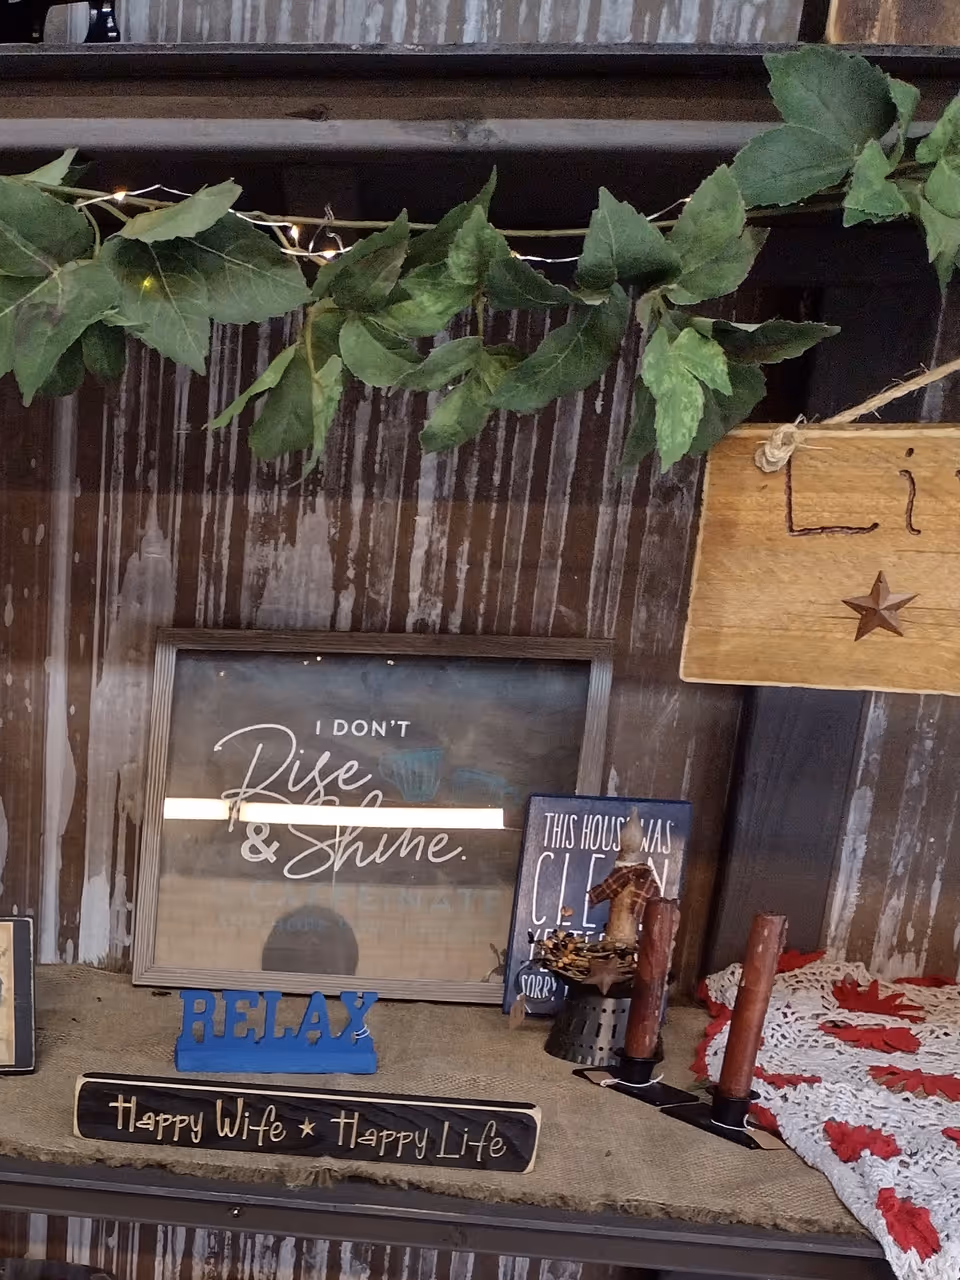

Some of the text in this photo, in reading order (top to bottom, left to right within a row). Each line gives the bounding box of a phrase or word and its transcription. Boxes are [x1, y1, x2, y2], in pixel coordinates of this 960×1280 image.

[785, 447, 960, 537] Li
[316, 719, 411, 738] I DON'T
[214, 723, 373, 832] Rise
[241, 822, 280, 863] &
[544, 812, 578, 849] THIS
[580, 814, 628, 851] HOUS
[531, 852, 669, 929] CLEN
[180, 991, 379, 1046] RELAX
[109, 1094, 507, 1162] Happy Wife Happy Life
